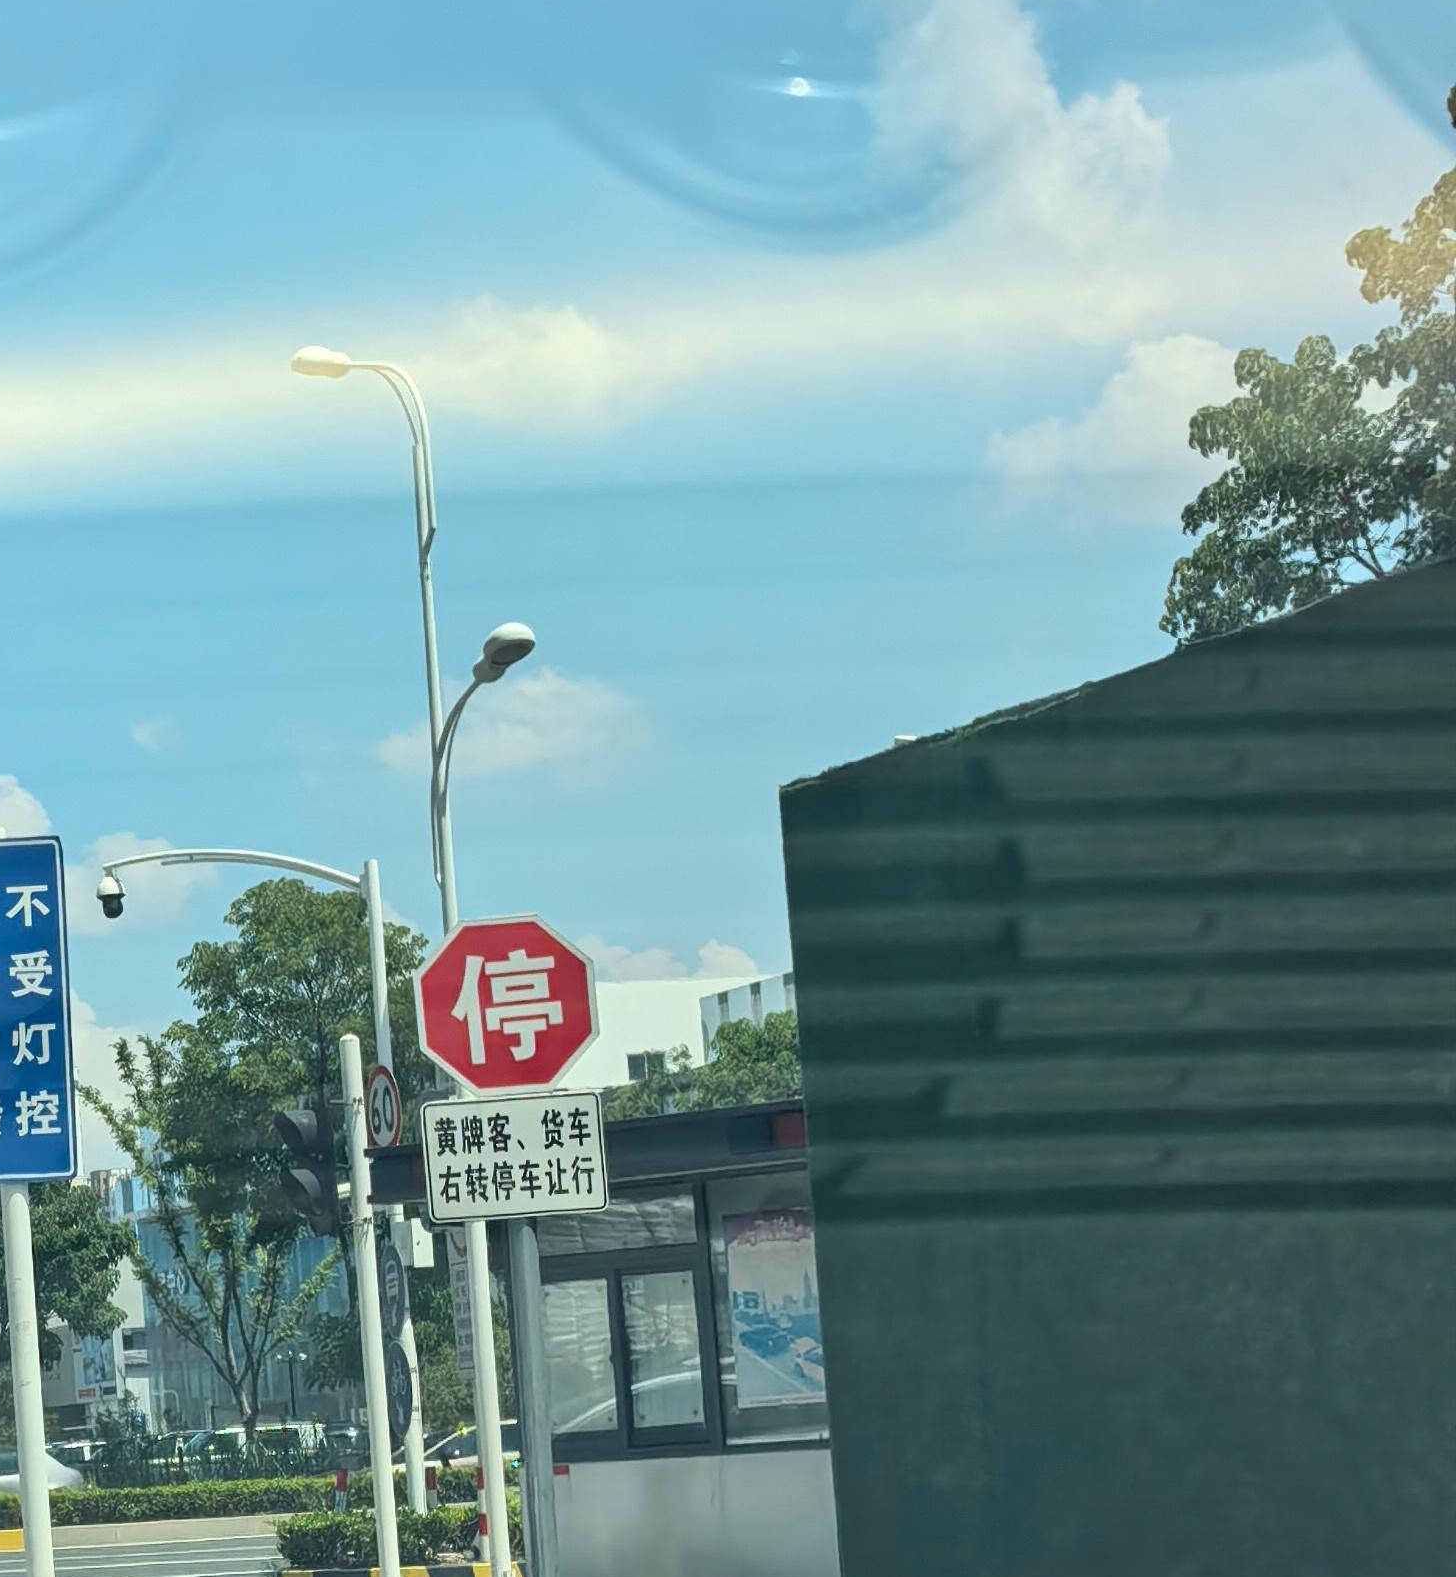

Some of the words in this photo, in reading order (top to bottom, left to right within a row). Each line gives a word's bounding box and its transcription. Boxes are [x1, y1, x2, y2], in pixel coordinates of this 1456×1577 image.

[5, 882, 63, 1137] 不受灯控
[450, 948, 564, 1066] 停
[372, 1085, 394, 1135] 60
[433, 1106, 593, 1158] 黄牌客、货车
[438, 1155, 596, 1205] 右转停车让行
